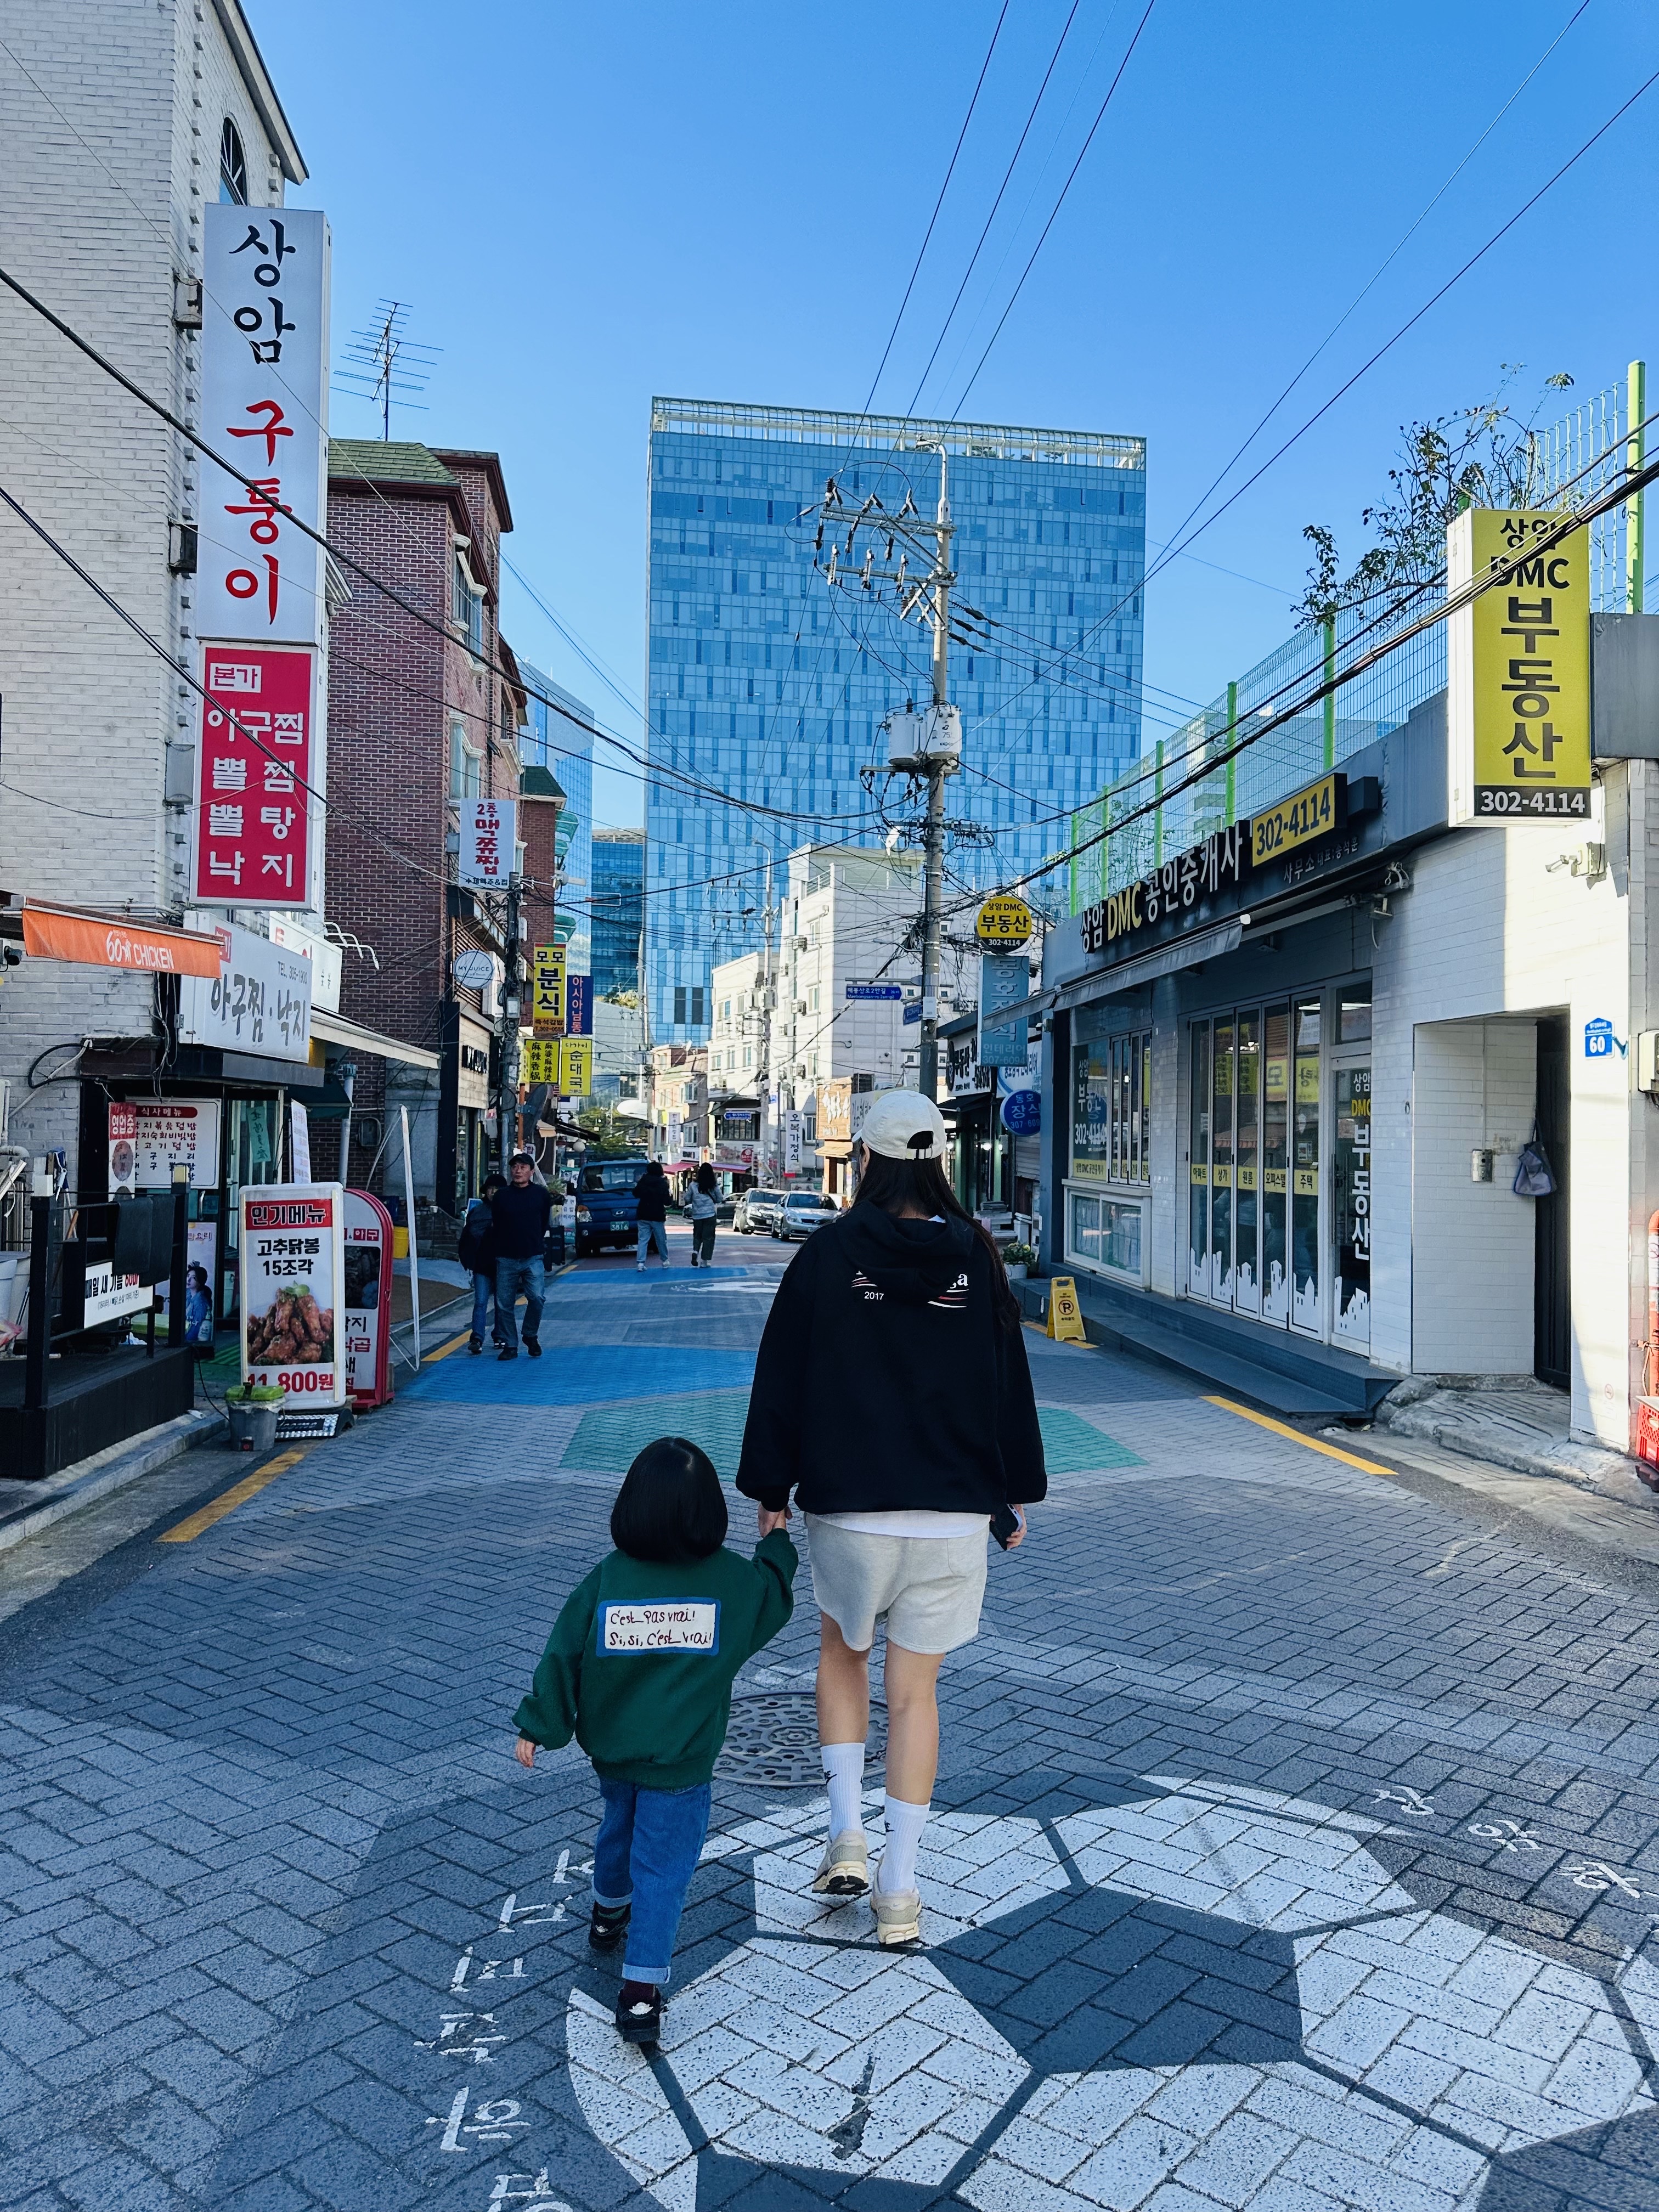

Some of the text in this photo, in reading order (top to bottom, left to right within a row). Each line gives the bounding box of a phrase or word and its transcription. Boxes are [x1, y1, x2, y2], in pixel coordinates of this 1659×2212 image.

[223, 218, 296, 626] 상암 구퉁이
[1499, 518, 1559, 551] 상암
[1489, 557, 1570, 589] DMC
[214, 667, 258, 688] 본가
[1500, 596, 1563, 779] 부동산
[207, 708, 304, 745] 아구찜
[477, 802, 498, 818] 2층
[1480, 791, 1585, 814] 302-4114
[1256, 786, 1331, 856] 302-4114
[1283, 854, 1315, 884] 사무소
[1080, 822, 1244, 953] 상암 DMC 공인중개사
[987, 902, 1022, 912] 상암 DMC
[980, 914, 1029, 933] 부동산
[133, 943, 174, 969] CHICKEN
[535, 951, 565, 963] 모모
[289, 965, 308, 985] 305-1900
[537, 968, 562, 1016] 분식
[211, 974, 307, 1047] 아구찜 낙지
[983, 1043, 1026, 1054] 인테리어
[1589, 1035, 1605, 1053] 60
[569, 1050, 583, 1088] 순대국
[983, 1054, 1026, 1065] 307-6094
[1353, 1073, 1371, 1092] 상암
[1015, 1093, 1034, 1104] 동호
[111, 1114, 134, 1135] 영업중
[1217, 1169, 1228, 1182] 상가
[1242, 1171, 1253, 1184] 원룸
[1265, 1173, 1286, 1188] 오피스텔
[1300, 1175, 1313, 1189] 주택
[1352, 1124, 1370, 1261] 부동산
[251, 1204, 326, 1226] 인기메뉴
[355, 1229, 379, 1240] 아구
[257, 1238, 320, 1257] 고추닭봉
[263, 1260, 314, 1277] 15조각
[100, 1275, 108, 1295] 새
[864, 1291, 884, 1300] 2017
[668, 1608, 696, 1622] vrai!
[610, 1632, 625, 1646] Si,
